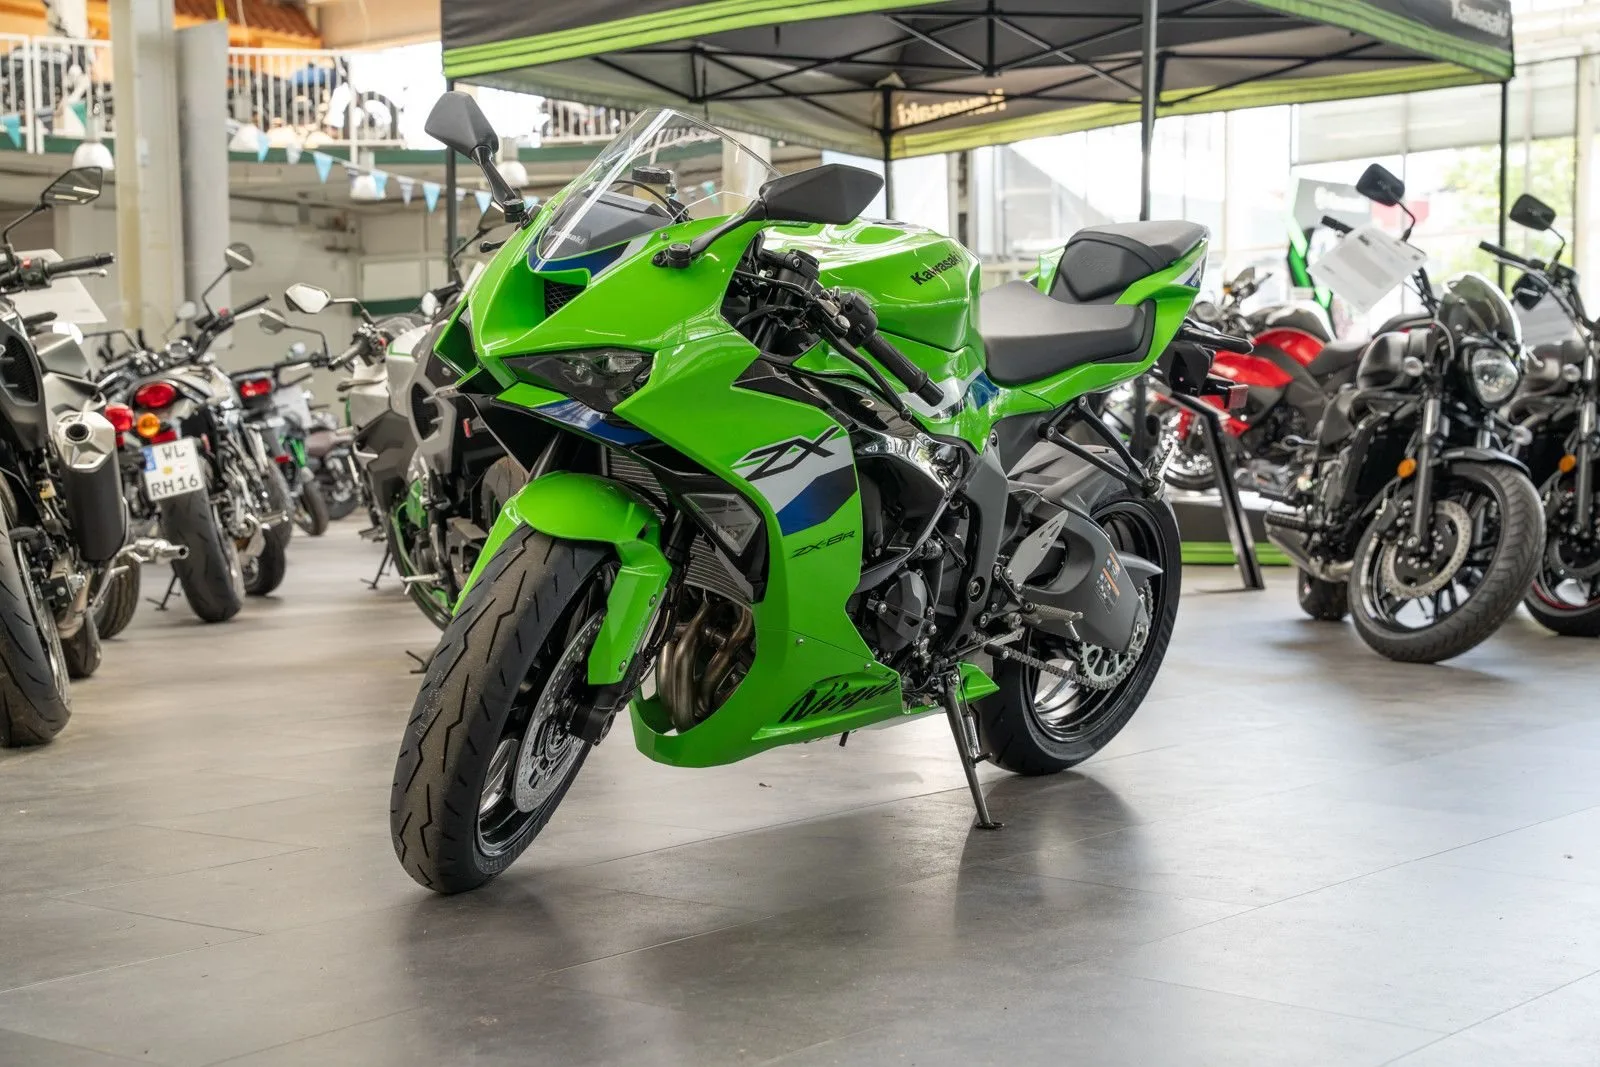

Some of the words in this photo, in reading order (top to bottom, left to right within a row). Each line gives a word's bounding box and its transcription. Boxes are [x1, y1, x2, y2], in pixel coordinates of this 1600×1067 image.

[1451, 0, 1509, 37] Kawasaki
[910, 251, 964, 287] Kawasaki
[162, 444, 185, 460] WL
[741, 426, 840, 482] ZX
[778, 672, 899, 724] Ninja
